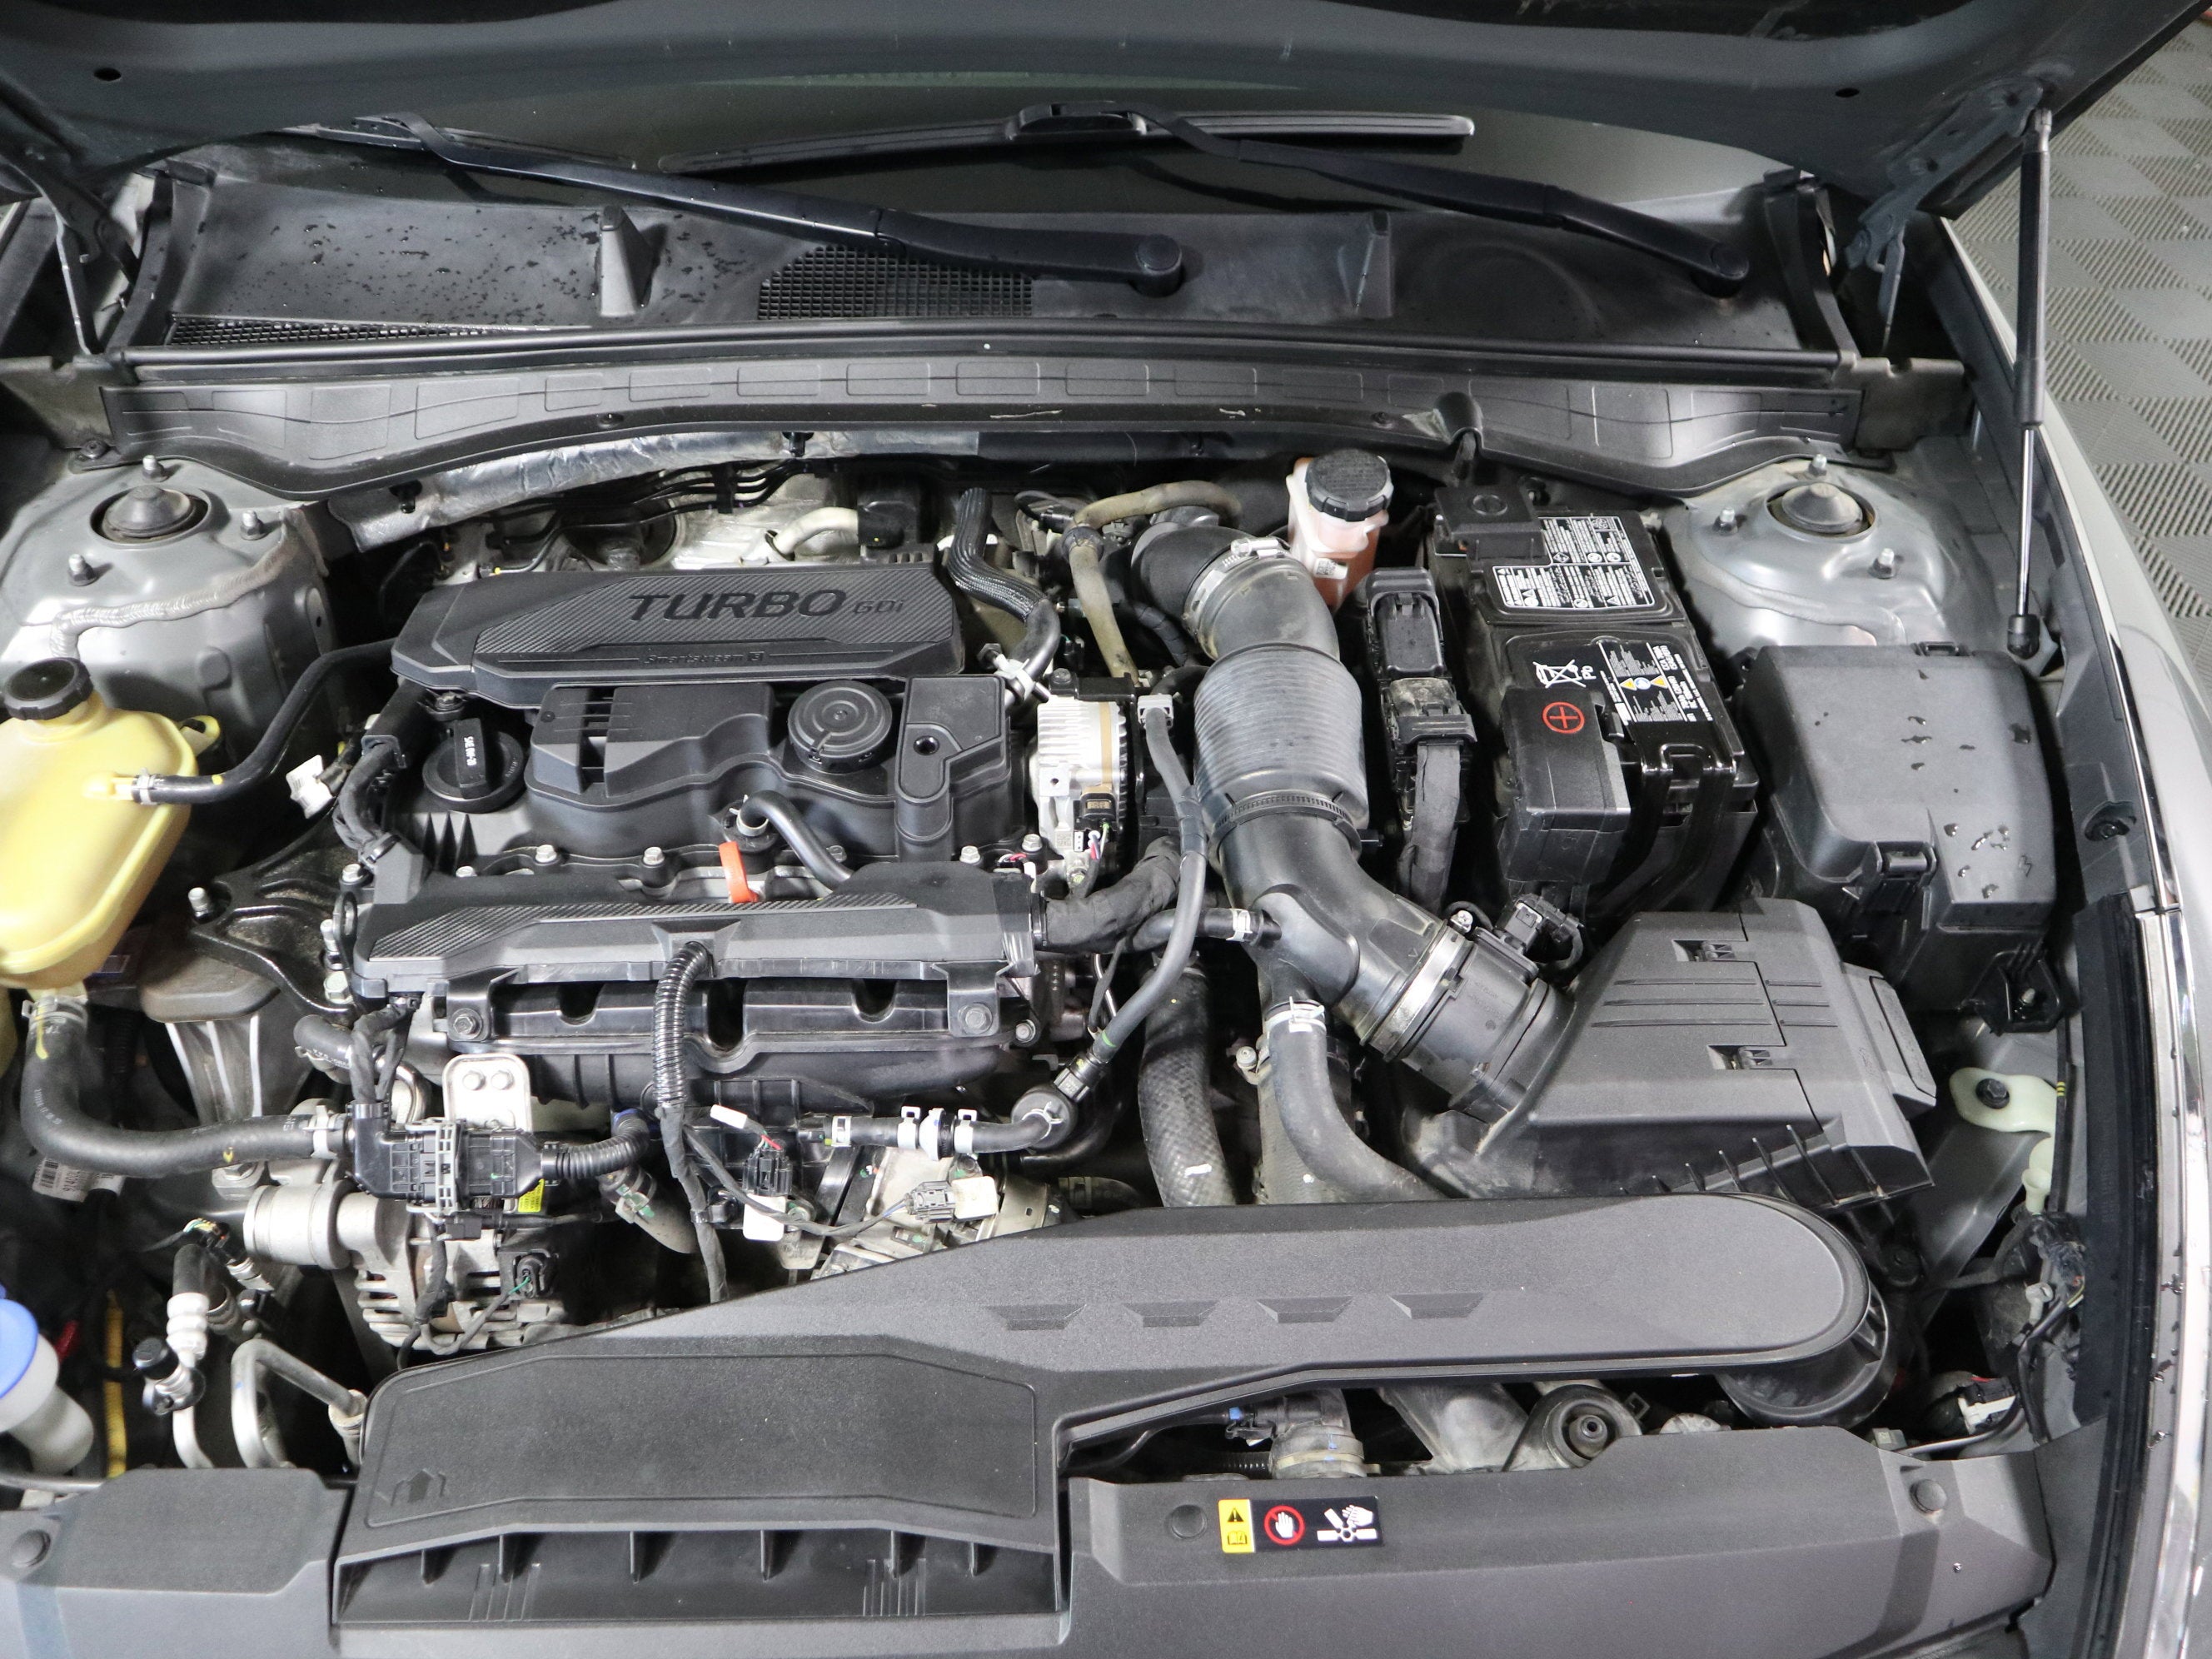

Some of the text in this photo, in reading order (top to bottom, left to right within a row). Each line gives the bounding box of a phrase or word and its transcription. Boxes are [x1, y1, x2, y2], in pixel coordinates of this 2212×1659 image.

[628, 589, 904, 621] TURBO GDi
[1581, 665, 1597, 680] Pb
[464, 736, 475, 748] SAE
